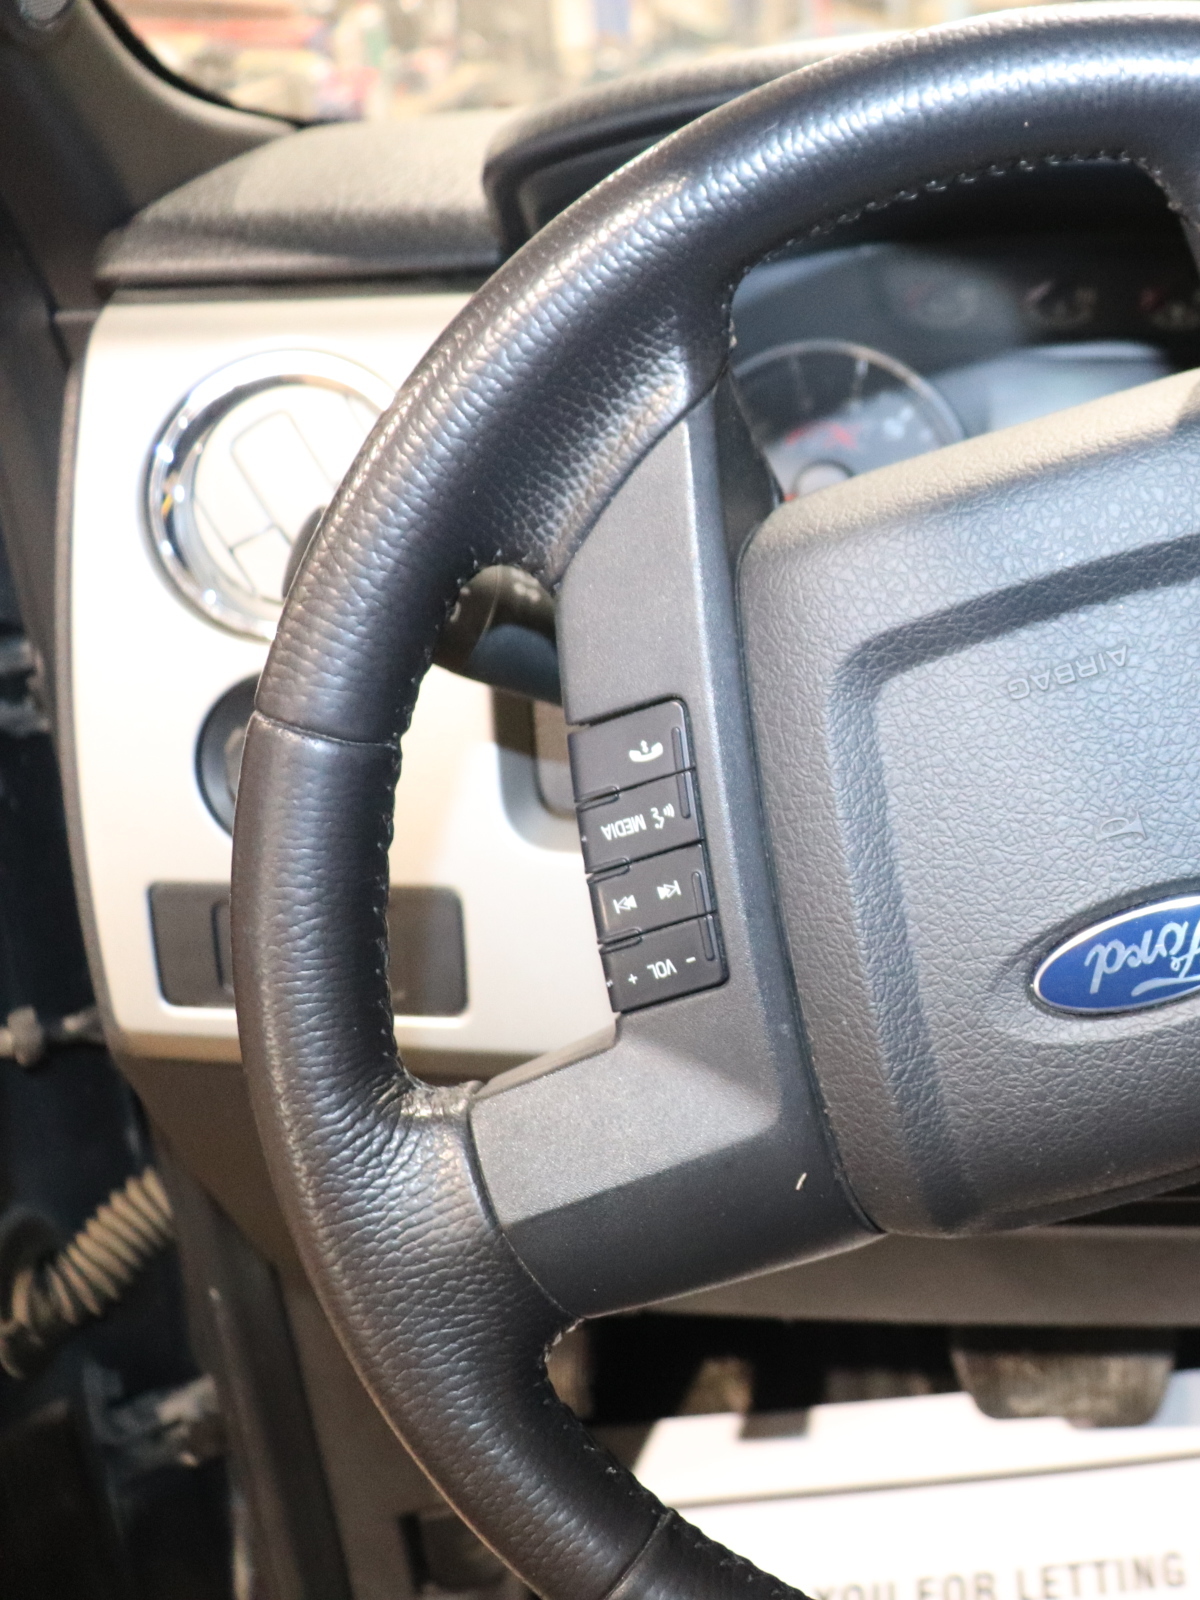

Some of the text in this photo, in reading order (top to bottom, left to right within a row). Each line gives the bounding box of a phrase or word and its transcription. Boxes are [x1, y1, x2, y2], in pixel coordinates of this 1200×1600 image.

[1007, 645, 1127, 700] AIRBAG
[601, 814, 647, 841] MEDIA
[647, 958, 678, 979] VOL
[914, 1572, 997, 1600] FOR
[1016, 1552, 1186, 1600] LETTING
